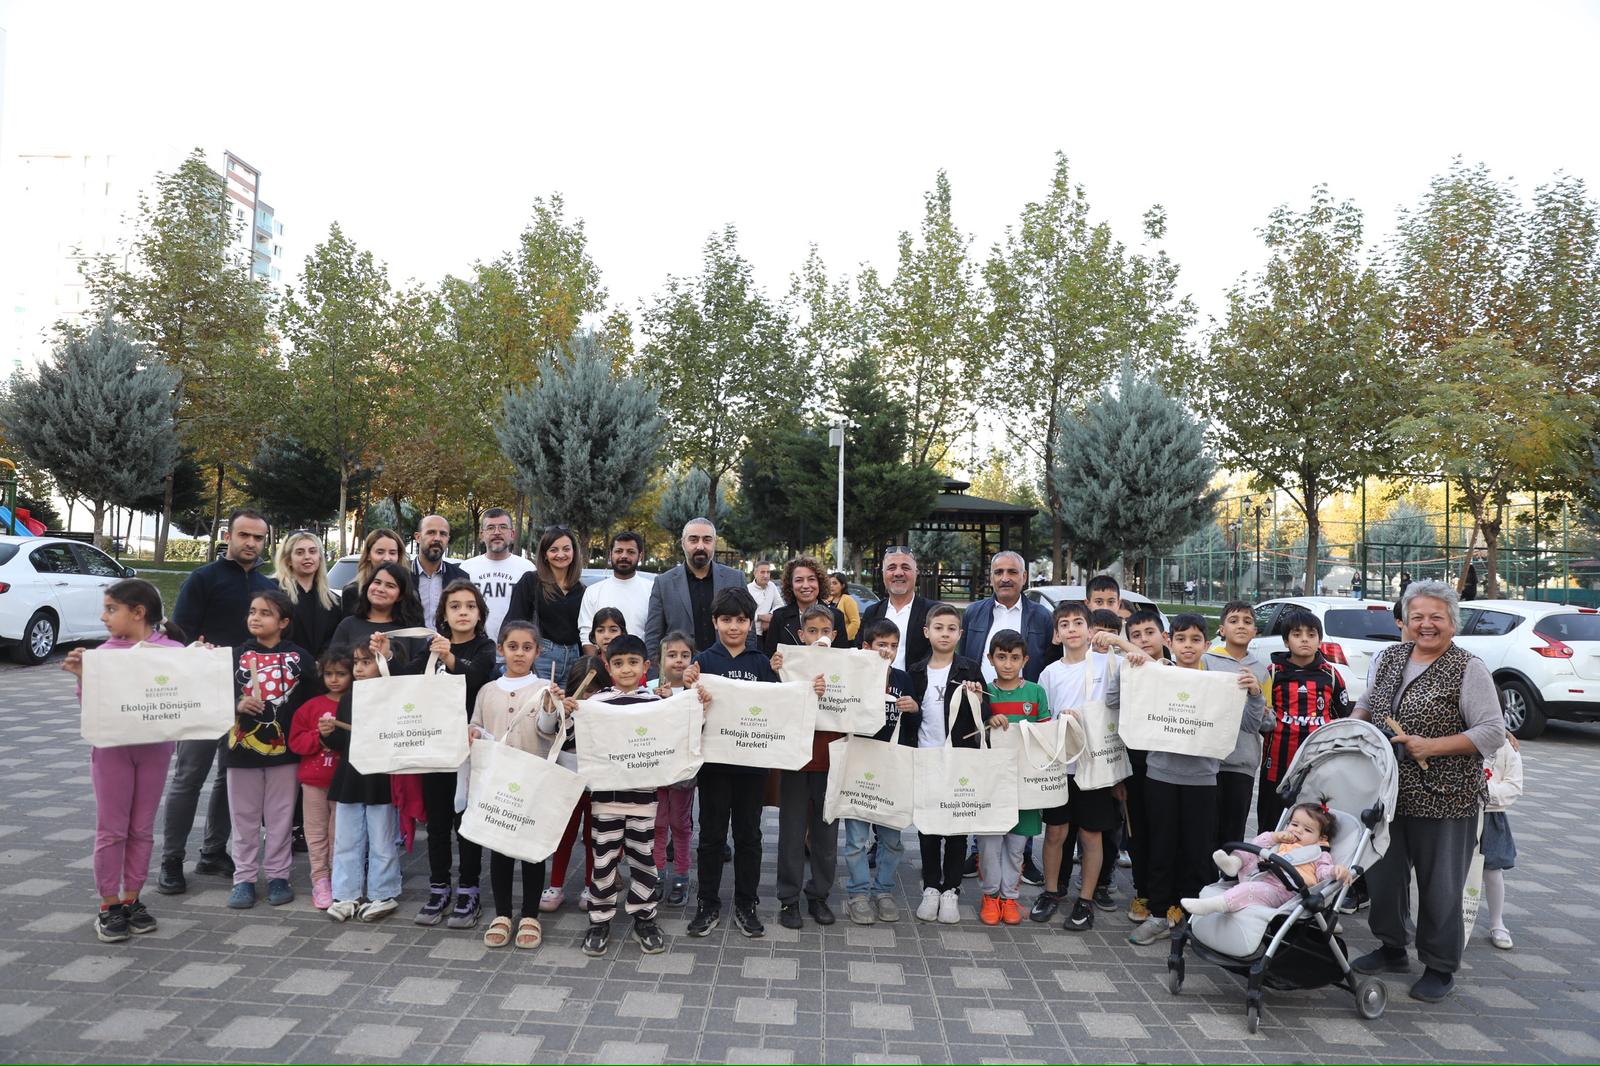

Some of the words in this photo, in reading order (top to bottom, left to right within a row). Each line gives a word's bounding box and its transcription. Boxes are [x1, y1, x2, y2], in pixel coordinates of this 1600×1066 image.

[492, 571, 513, 580] HAVEN
[121, 702, 158, 712] Ekolojik
[160, 700, 201, 711] Dönüşüm
[142, 711, 181, 721] Hareketi
[1147, 713, 1178, 724] Ekolojik
[1179, 717, 1214, 728] Dönüşüm
[1281, 711, 1325, 727] bwin
[406, 728, 442, 738] Dönüşüm
[720, 728, 749, 739] Ekolojik
[751, 731, 786, 741] Dönüşüm
[1163, 725, 1196, 736] Hareketi
[394, 738, 426, 748] Hareketi
[735, 740, 768, 749] Hareketi
[608, 752, 636, 762] Tevgera
[1023, 776, 1049, 784] Tevgera
[940, 801, 961, 809] Ekolojik
[478, 801, 500, 814] olojik
[501, 809, 536, 826] Dönüşüm
[485, 814, 517, 832] Hareketi
